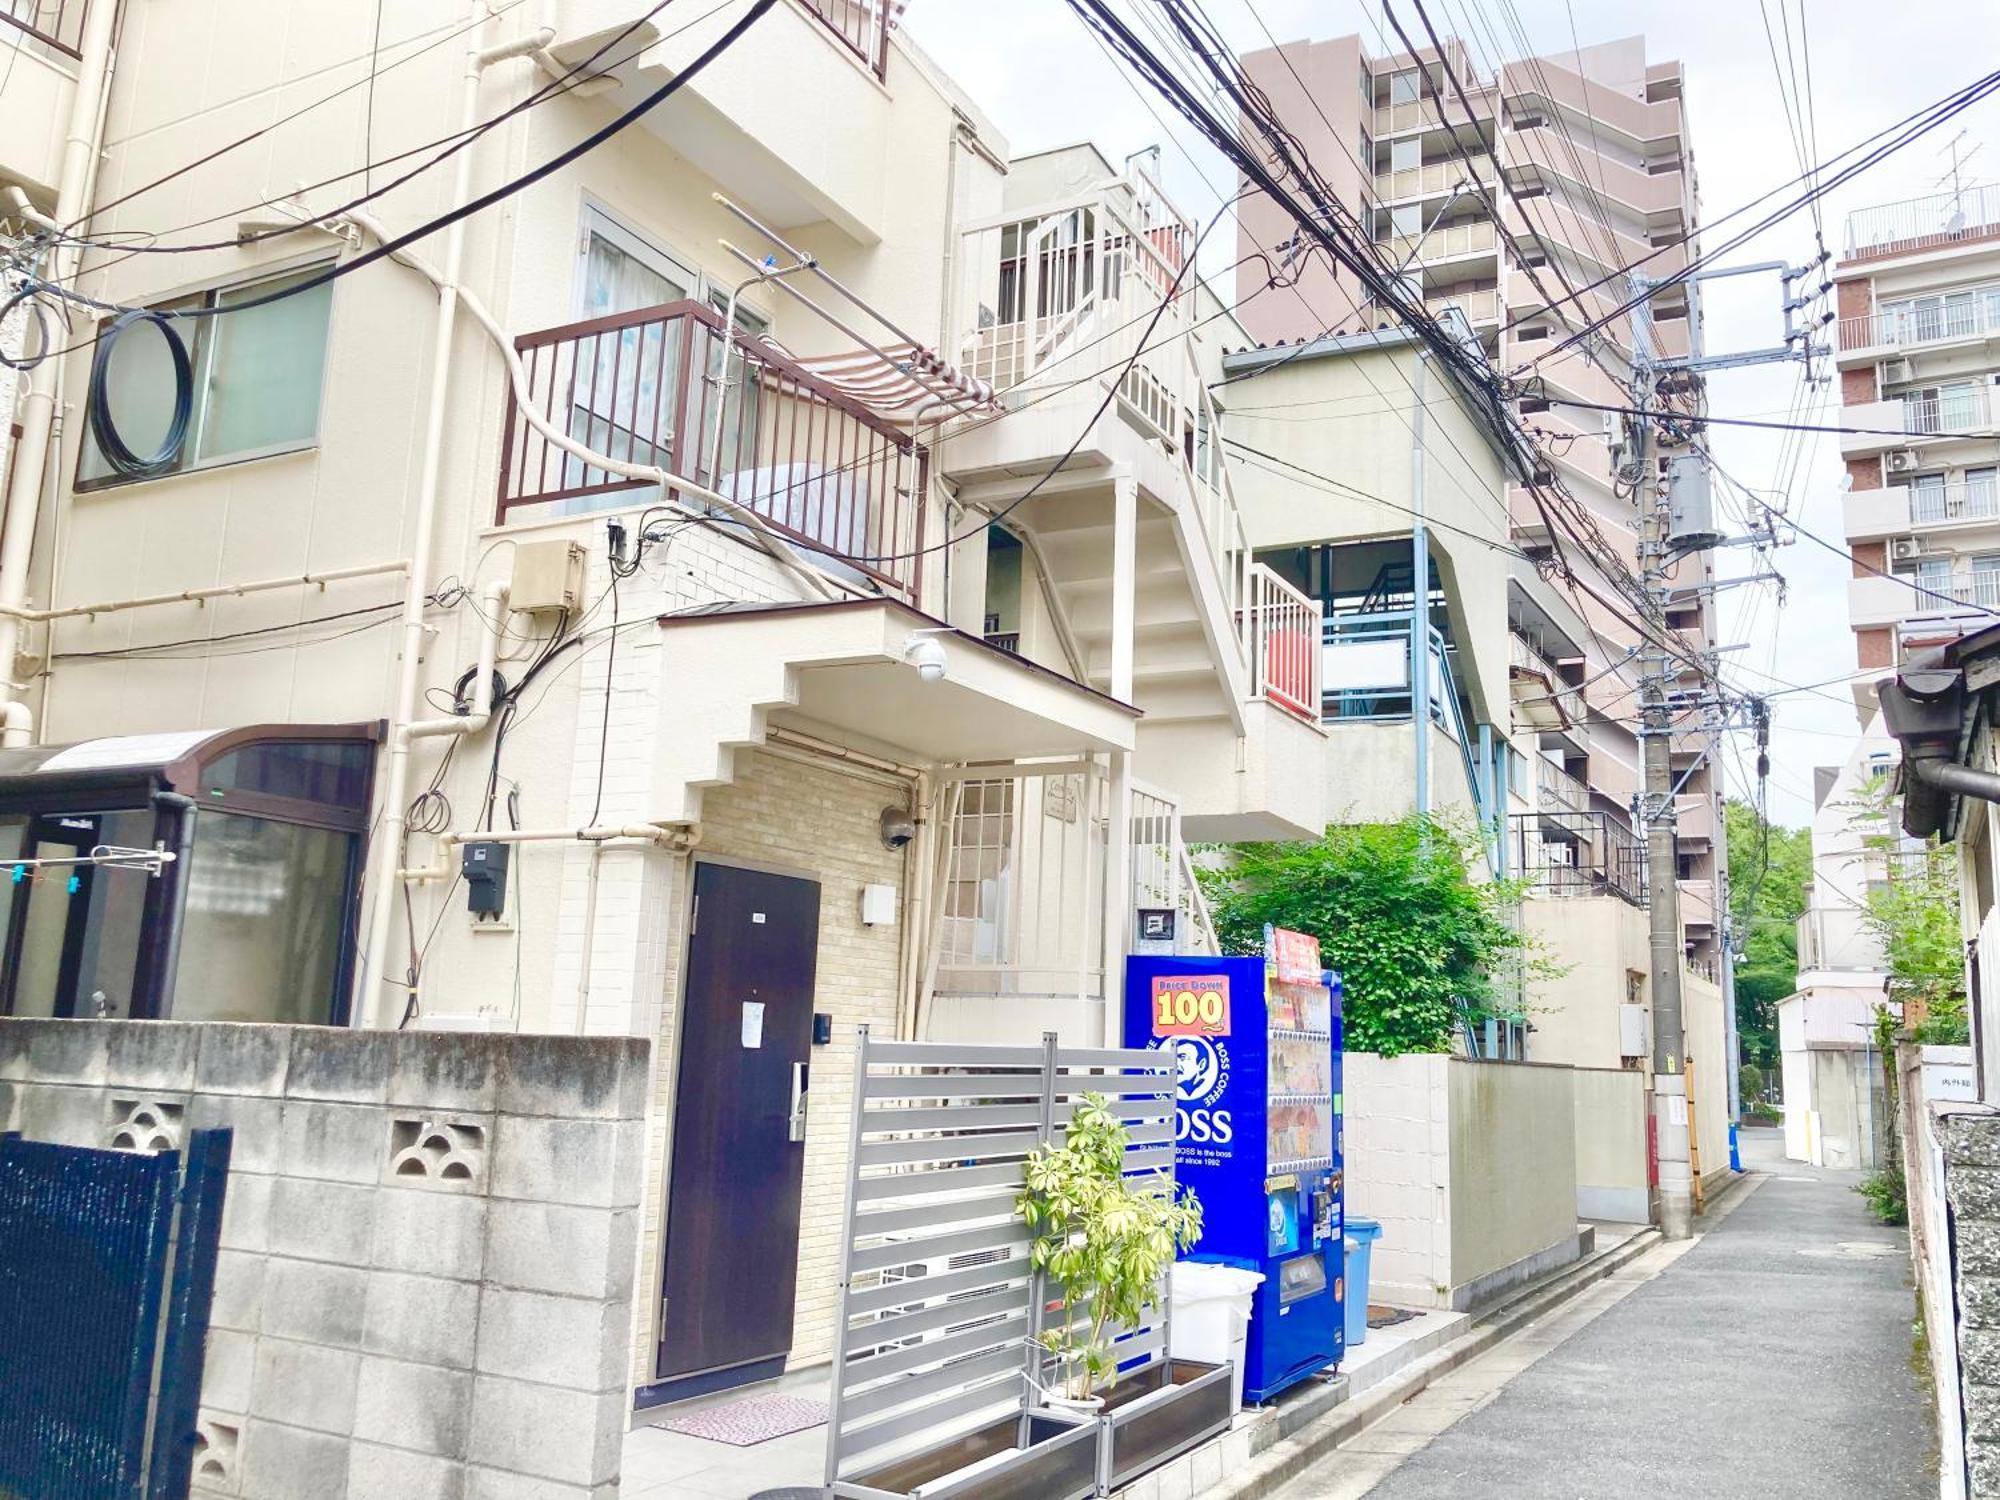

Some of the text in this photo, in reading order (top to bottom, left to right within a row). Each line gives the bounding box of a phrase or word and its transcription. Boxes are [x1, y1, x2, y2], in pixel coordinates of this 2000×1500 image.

[1157, 990, 1224, 1026] 100
[1215, 1041, 1231, 1071] BOSS
[1203, 1072, 1229, 1107] COFFEE
[1176, 1108, 1232, 1143] OSS
[1204, 1149, 1214, 1157] the
[1215, 1150, 1232, 1158] boss
